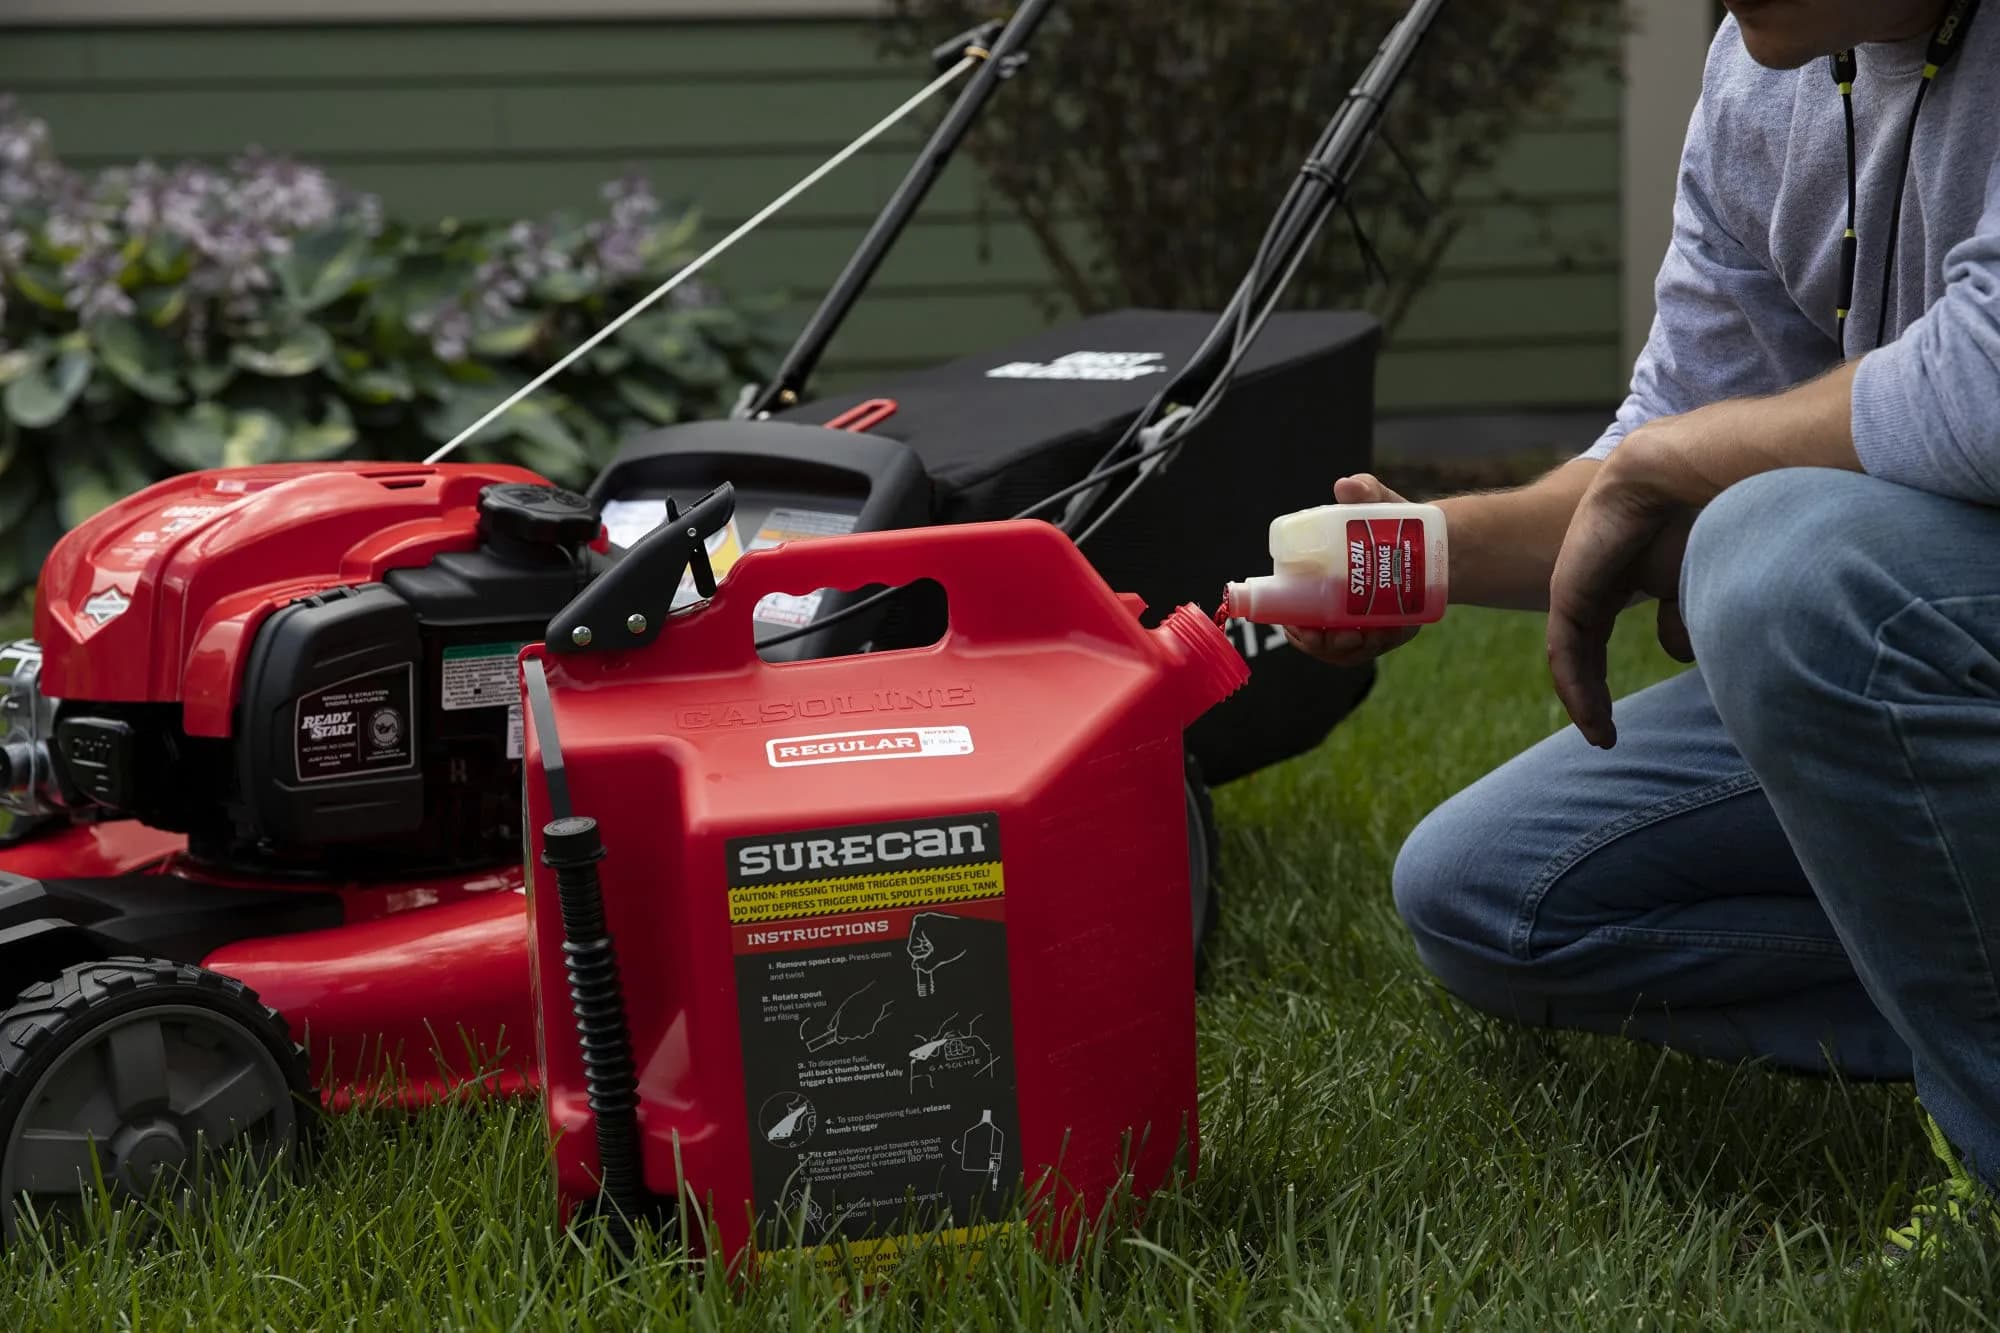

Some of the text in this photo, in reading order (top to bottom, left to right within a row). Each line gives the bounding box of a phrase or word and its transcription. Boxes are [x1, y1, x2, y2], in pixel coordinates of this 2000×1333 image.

[1350, 540, 1365, 596] STA-BIL
[1378, 545, 1391, 589] STORAGE
[675, 685, 977, 730] GASOLINE
[301, 712, 352, 730] READY
[311, 723, 357, 739] START
[779, 736, 917, 759] REGULAR
[732, 869, 991, 903] CAUTION: PRESSING THUMB TRIGGER DISPENSES FUEL!
[733, 879, 998, 917] DO NOT DEPRESS TRIGGER UNTIL SPOUT IS IN FUEL TANK
[747, 920, 889, 946] INSTRUCTIONS
[775, 961, 807, 969] Remove
[808, 957, 831, 967] spout
[848, 953, 870, 962] Press
[871, 951, 892, 959] down
[769, 971, 805, 981] and twist
[772, 992, 799, 1002] Rotate
[799, 990, 822, 1000] spout
[763, 1000, 828, 1012] into fuel tank you
[799, 1062, 886, 1079] pull back thumb safety
[808, 1060, 817, 1068] To
[818, 1058, 851, 1068] dispense
[799, 1078, 826, 1088] trigger
[835, 1075, 853, 1083] then
[854, 1072, 885, 1082] depress
[885, 1068, 904, 1078] fully
[838, 1115, 846, 1123] To
[847, 1114, 864, 1123] stop
[865, 1109, 905, 1120] dispensing
[923, 1103, 951, 1113] release
[826, 1123, 879, 1135] thumb trigger
[823, 1150, 837, 1158] can
[838, 1146, 872, 1156] sideways
[888, 1140, 919, 1149] towards
[920, 1136, 942, 1147] spout
[810, 1167, 830, 1175] Make
[848, 1162, 870, 1171] spout
[879, 1157, 906, 1166] rotated
[925, 1152, 943, 1160] from
[826, 1157, 846, 1165] drain
[847, 1153, 871, 1162] before
[872, 1149, 913, 1160] proceeding
[815, 1173, 841, 1182] stowed
